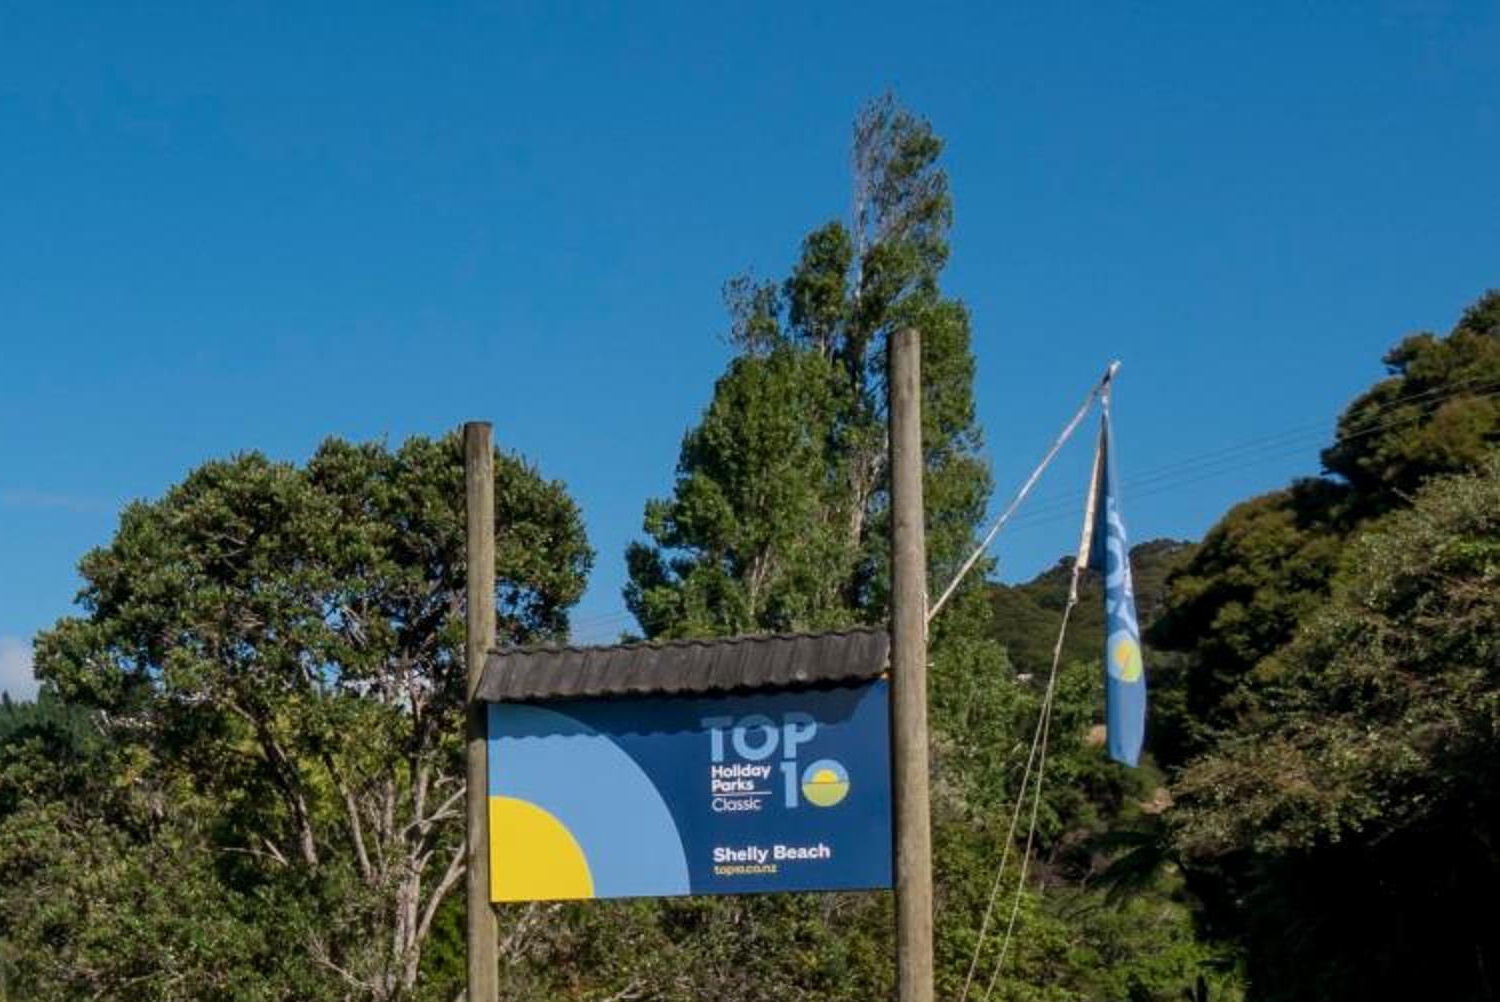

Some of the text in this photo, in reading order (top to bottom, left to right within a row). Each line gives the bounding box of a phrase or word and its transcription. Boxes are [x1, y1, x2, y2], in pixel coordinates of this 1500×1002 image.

[701, 711, 817, 763] TOP
[711, 764, 772, 780] Holiday
[711, 779, 755, 793] Parks
[711, 797, 763, 812] Classic
[713, 842, 831, 864] Shelly Beach
